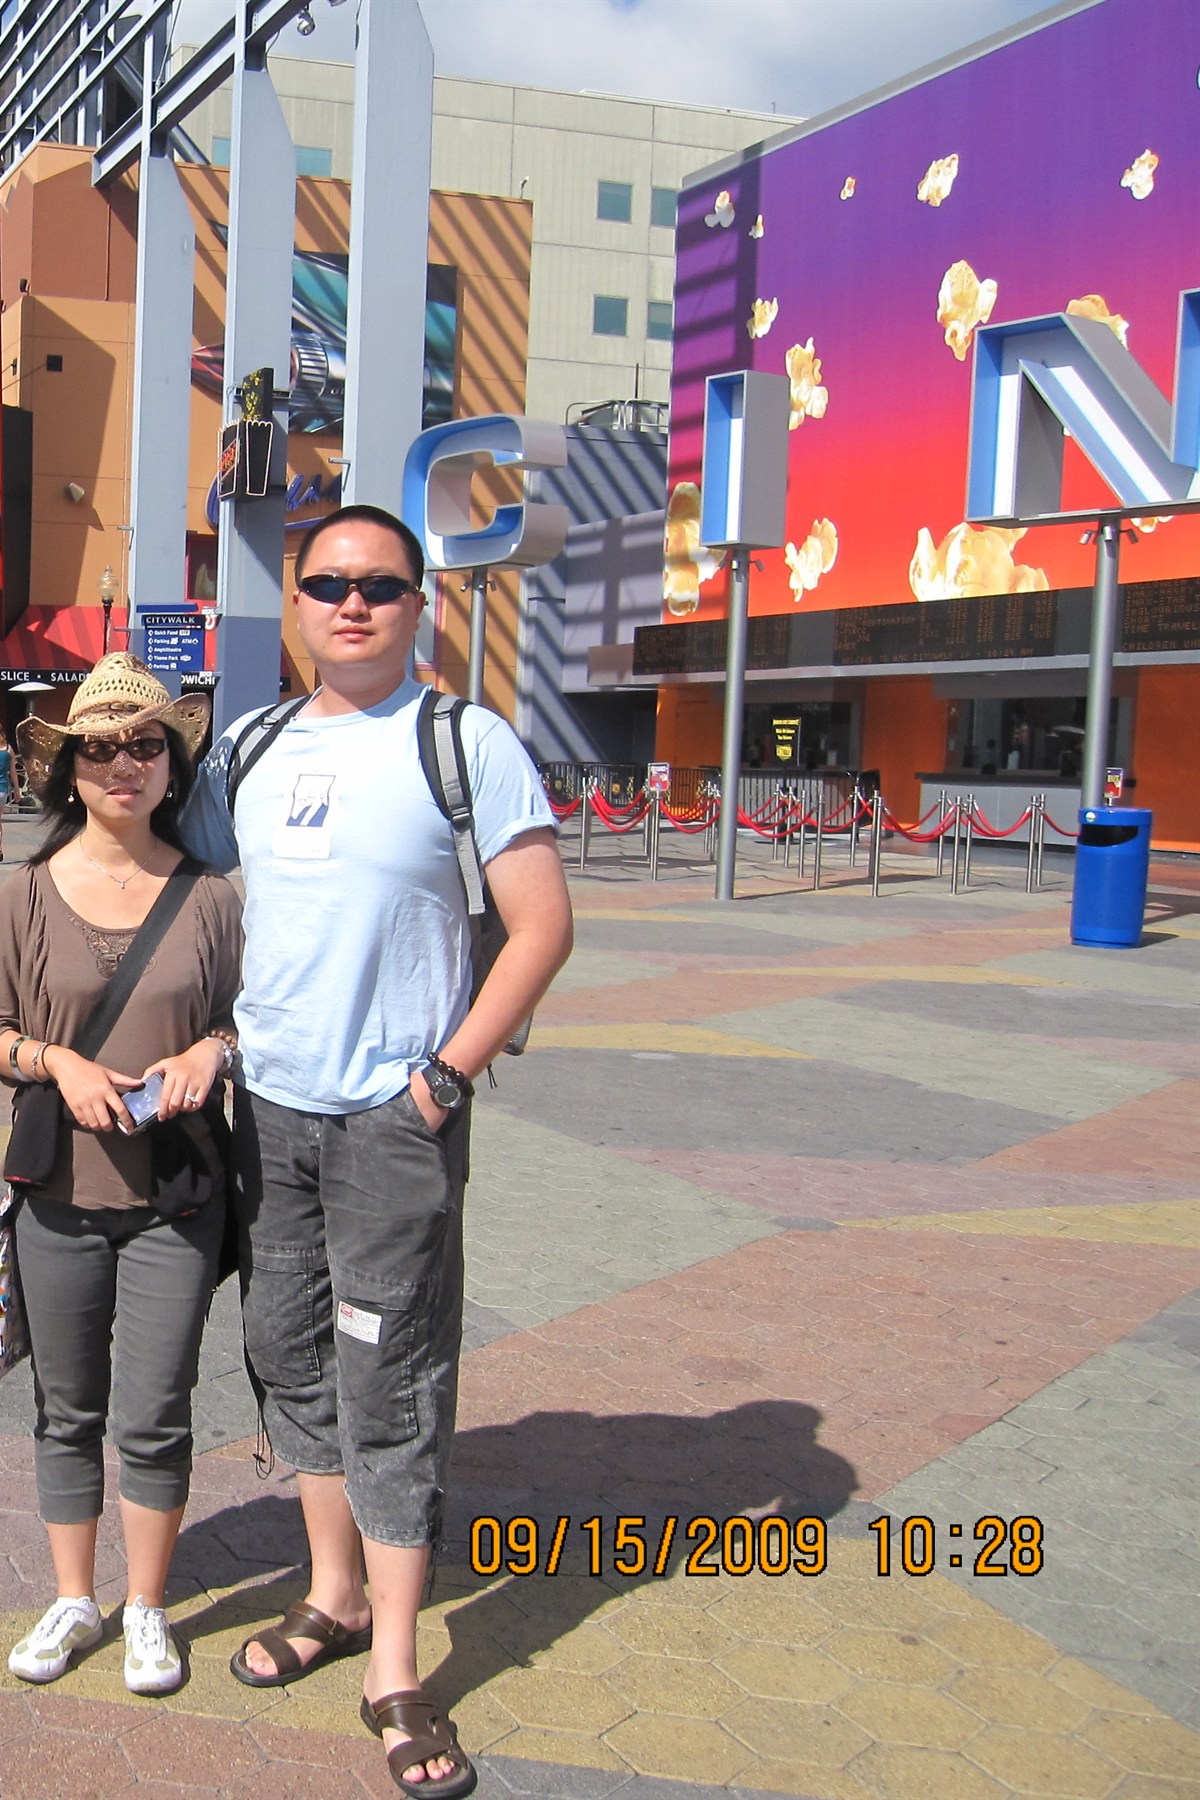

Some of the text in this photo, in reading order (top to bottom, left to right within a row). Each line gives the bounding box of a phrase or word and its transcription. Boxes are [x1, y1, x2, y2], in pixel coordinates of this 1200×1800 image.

[145, 615, 196, 624] CITYWALK
[1121, 640, 1177, 653] CHILDREN
[0, 671, 30, 681] SLICE
